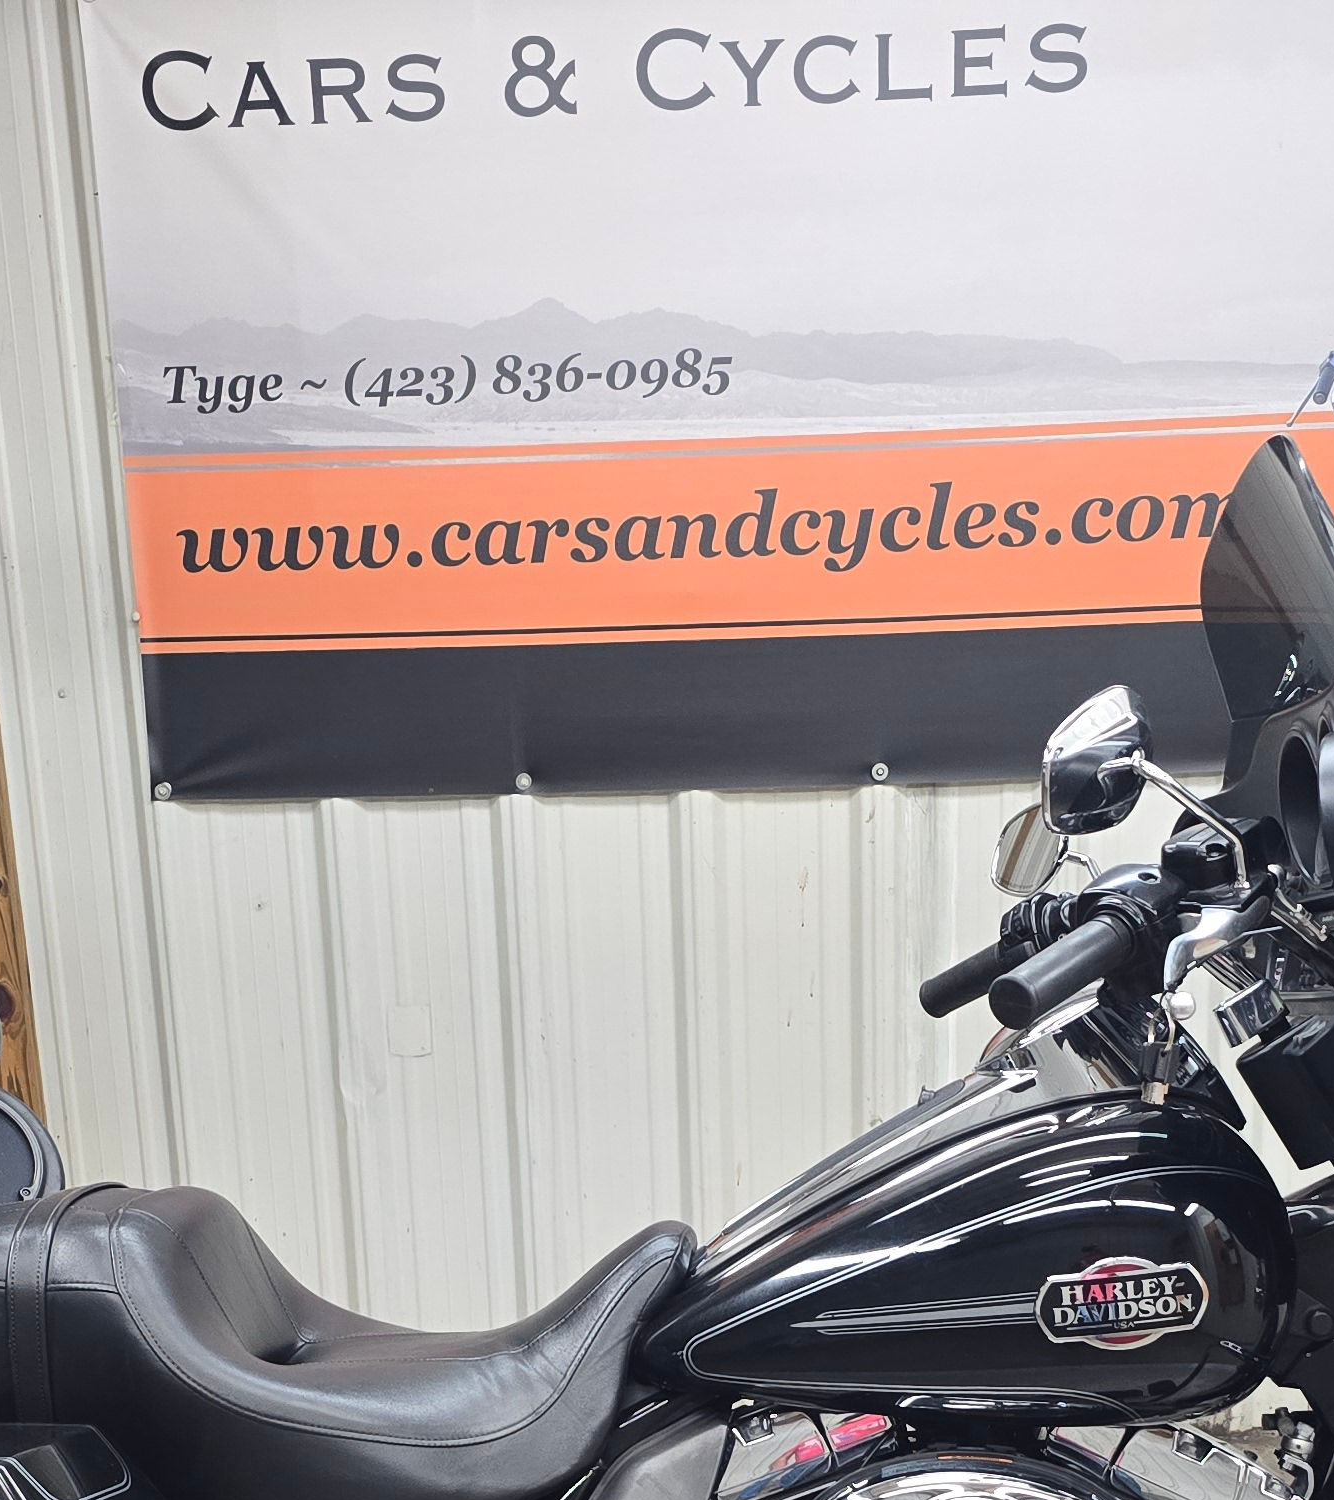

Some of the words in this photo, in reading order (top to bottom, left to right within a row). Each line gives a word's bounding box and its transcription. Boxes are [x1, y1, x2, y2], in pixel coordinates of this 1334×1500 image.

[504, 35, 578, 118] &
[163, 365, 283, 414] Tyge
[344, 355, 477, 406] (423)
[493, 348, 733, 402] 836-0985
[176, 482, 1232, 573] www.carsandcycles.com
[1113, 1320, 1135, 1329] USA
